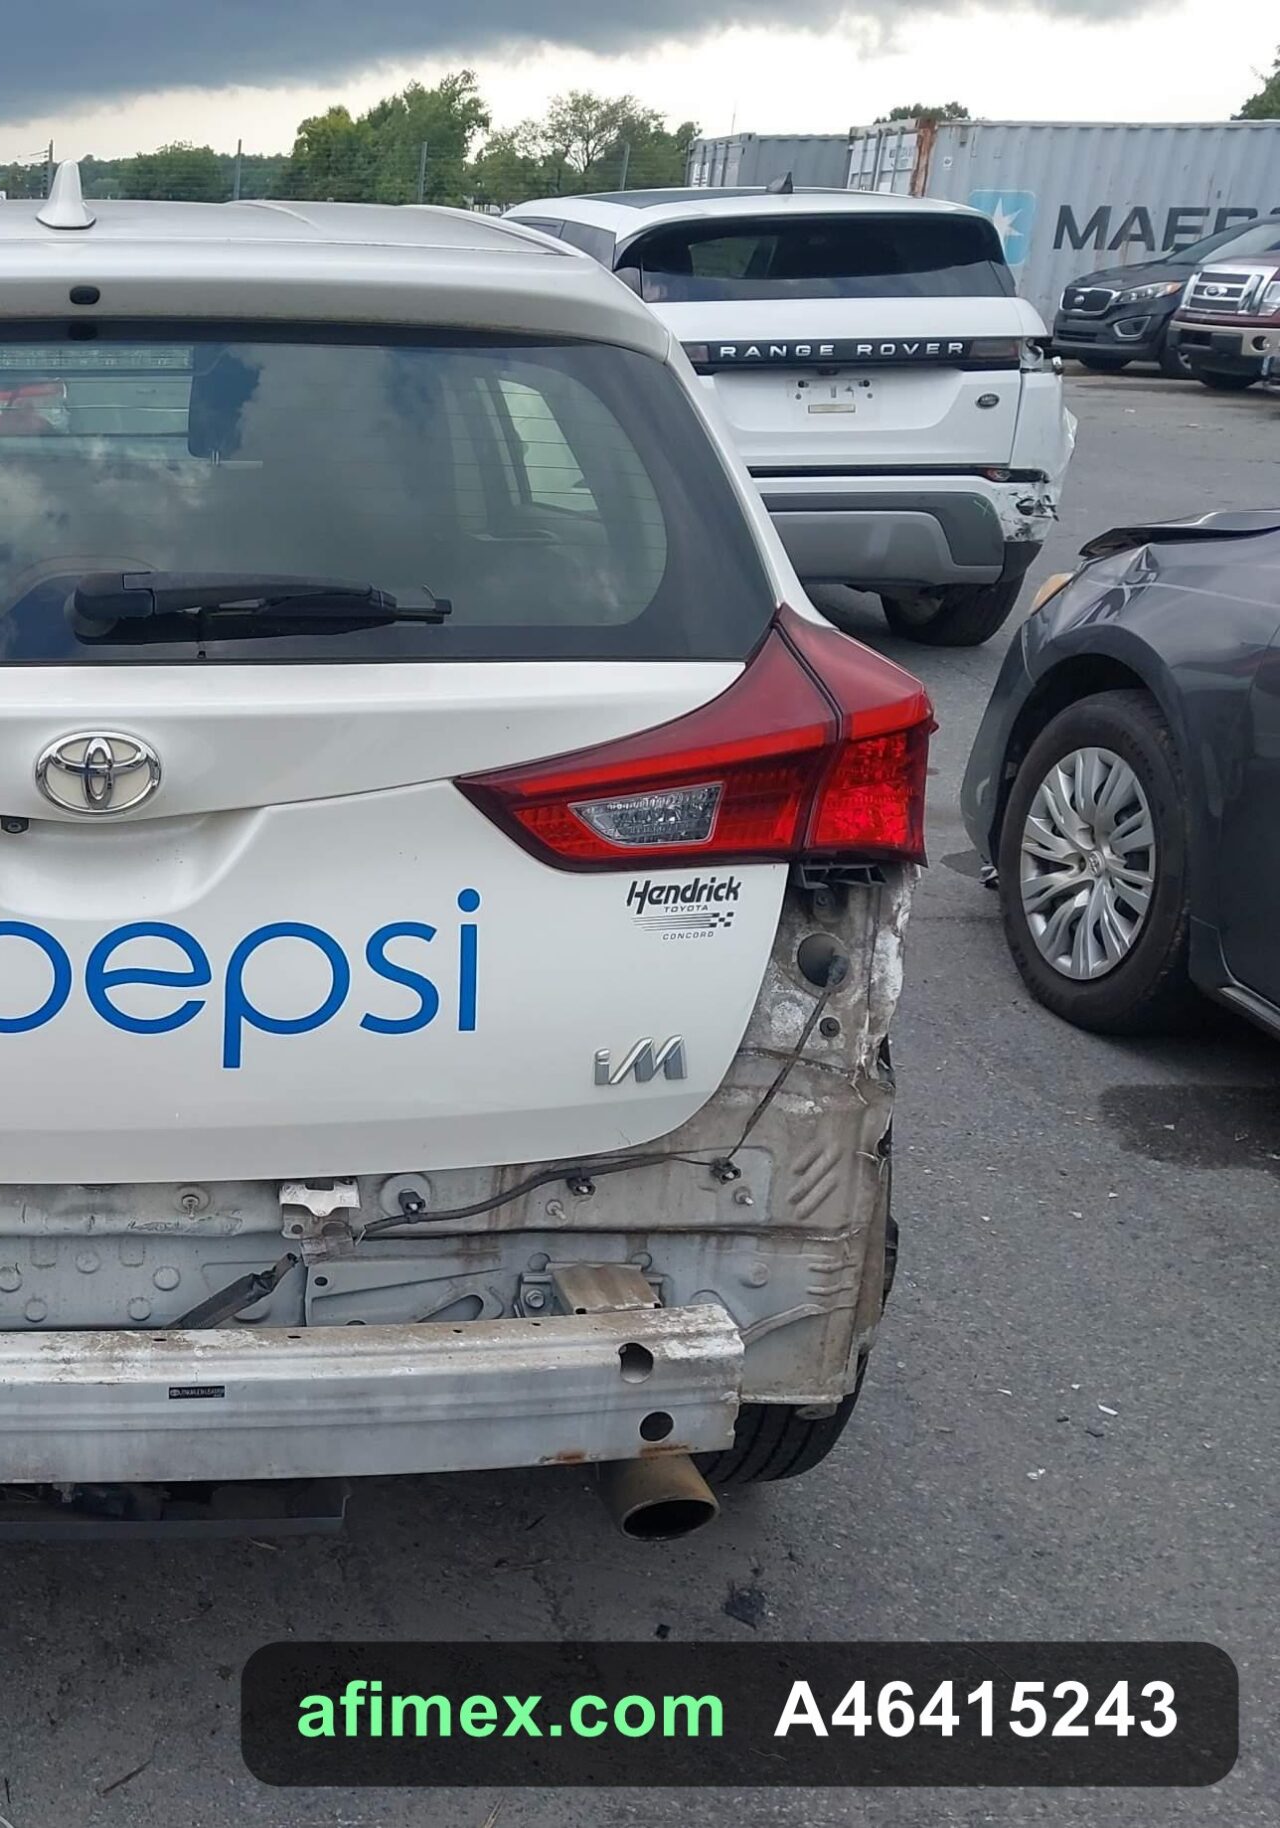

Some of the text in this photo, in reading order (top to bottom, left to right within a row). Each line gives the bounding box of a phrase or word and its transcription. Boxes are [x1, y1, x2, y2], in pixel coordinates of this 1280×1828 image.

[1052, 204, 1280, 252] MAE
[720, 342, 966, 358] RANGE ROVER
[626, 876, 742, 915] Hendrick
[663, 904, 709, 914] TOYOTA
[662, 930, 715, 941] CONCORD
[594, 1034, 688, 1086] iM
